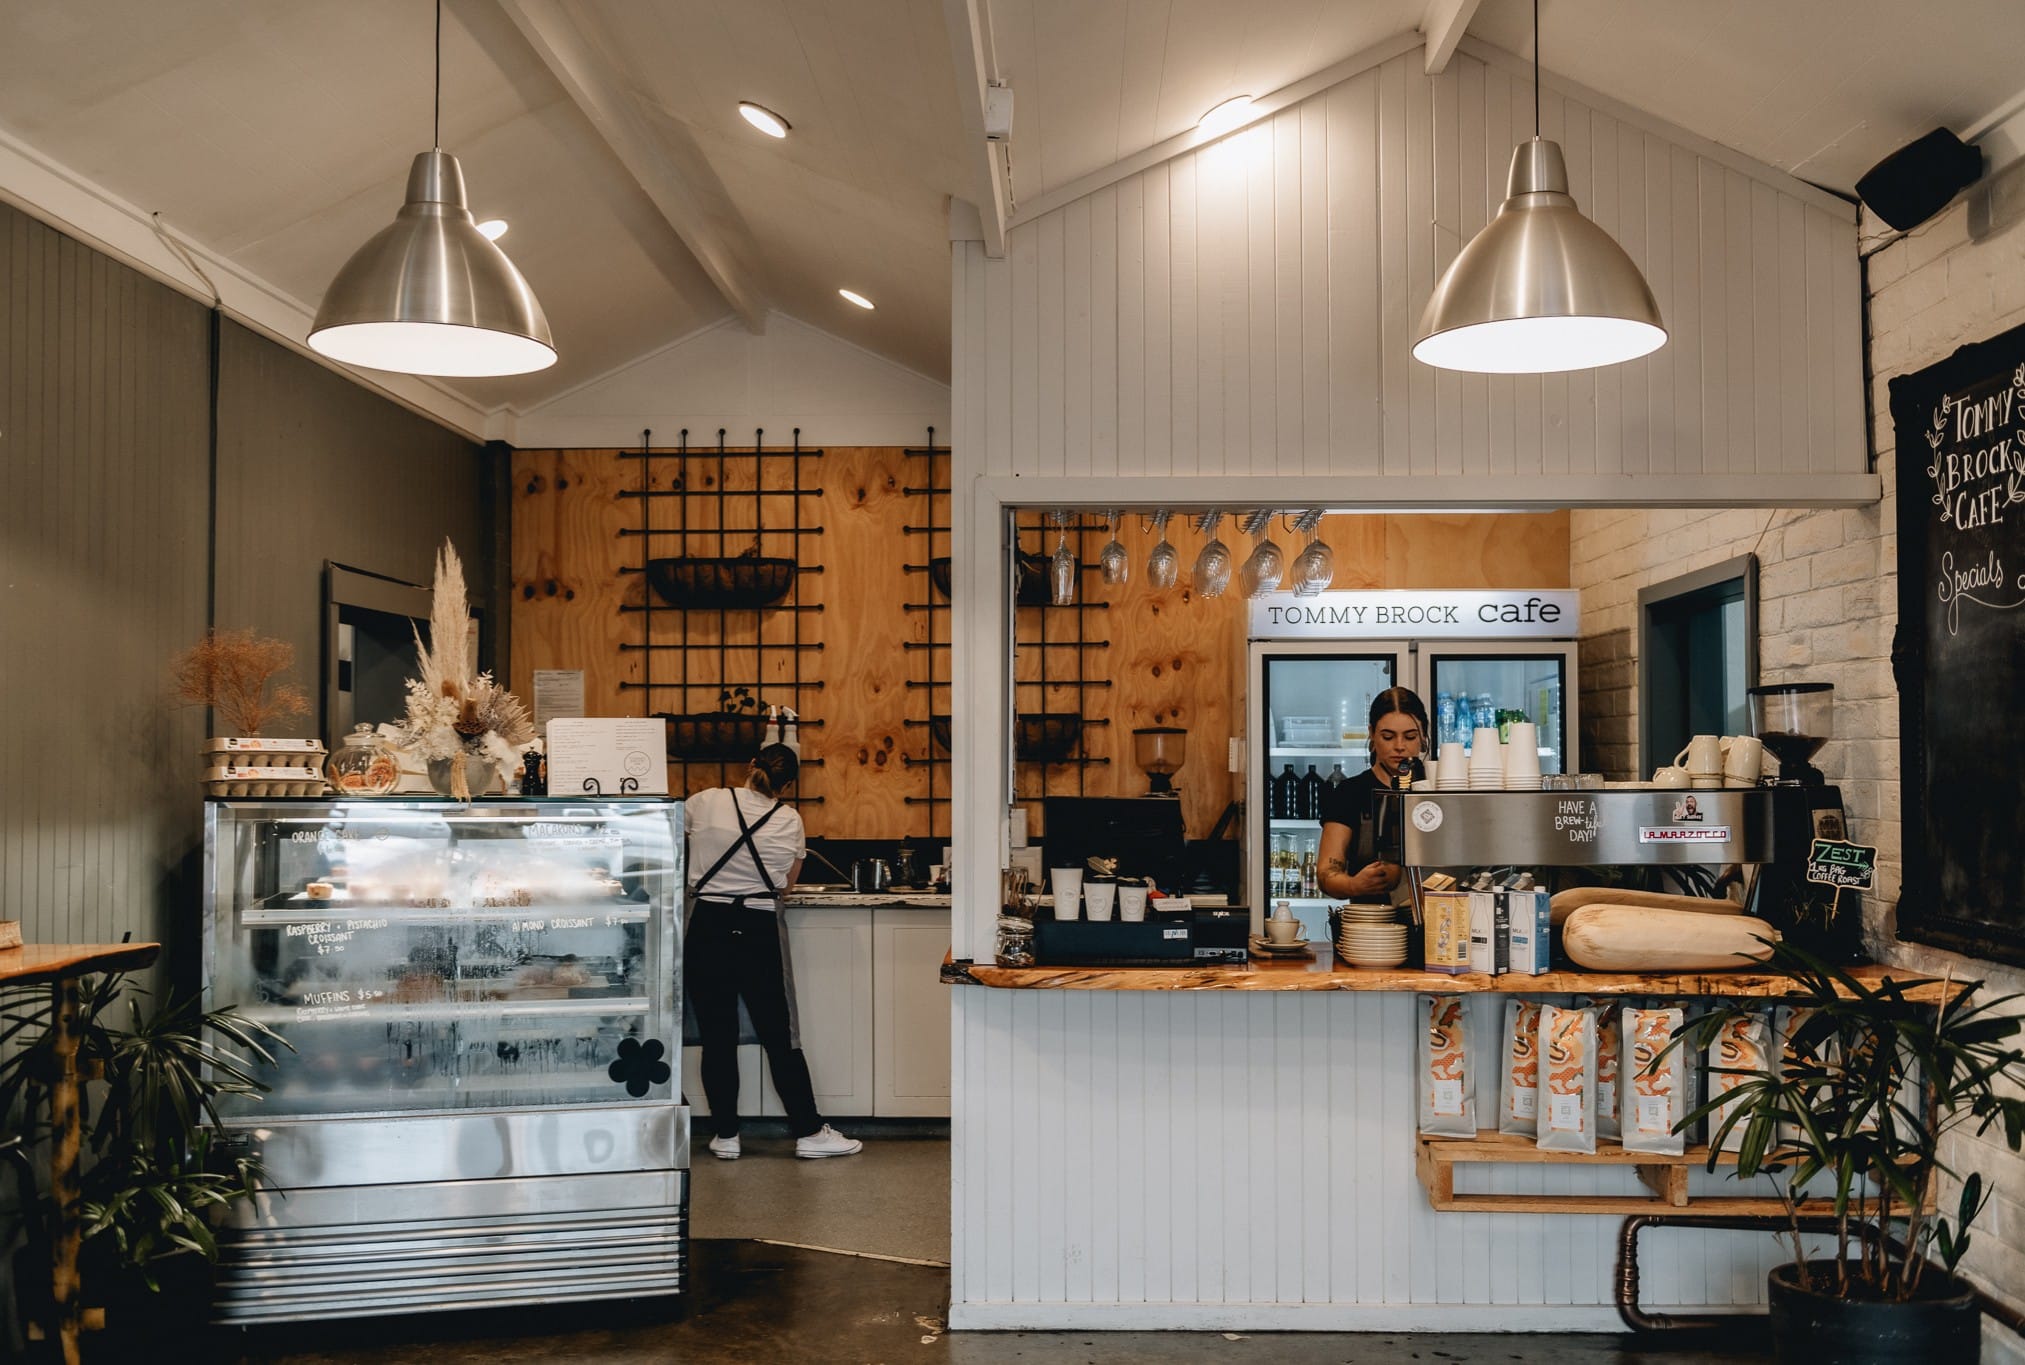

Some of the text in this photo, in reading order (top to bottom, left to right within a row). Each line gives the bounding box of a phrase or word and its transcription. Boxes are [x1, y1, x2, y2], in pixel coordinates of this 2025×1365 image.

[1950, 387, 2014, 442] TOMMY
[1946, 439, 2013, 493] BROCK
[1955, 484, 2003, 530] CAFE
[1938, 551, 2003, 636] Specials
[1268, 598, 1561, 625] TOMMY BROCK cafe
[1558, 800, 1597, 815] HAVE A
[1569, 829, 1593, 842] DAY!
[1815, 843, 1865, 863] ZEST
[1830, 864, 1847, 876] BAG
[1812, 872, 1861, 885] COFFEE ROAST
[286, 922, 331, 936] RASPBERRY
[550, 917, 595, 930] CROISSANT
[307, 930, 355, 945] CROISSANT
[303, 990, 350, 1005] MUFFINS
